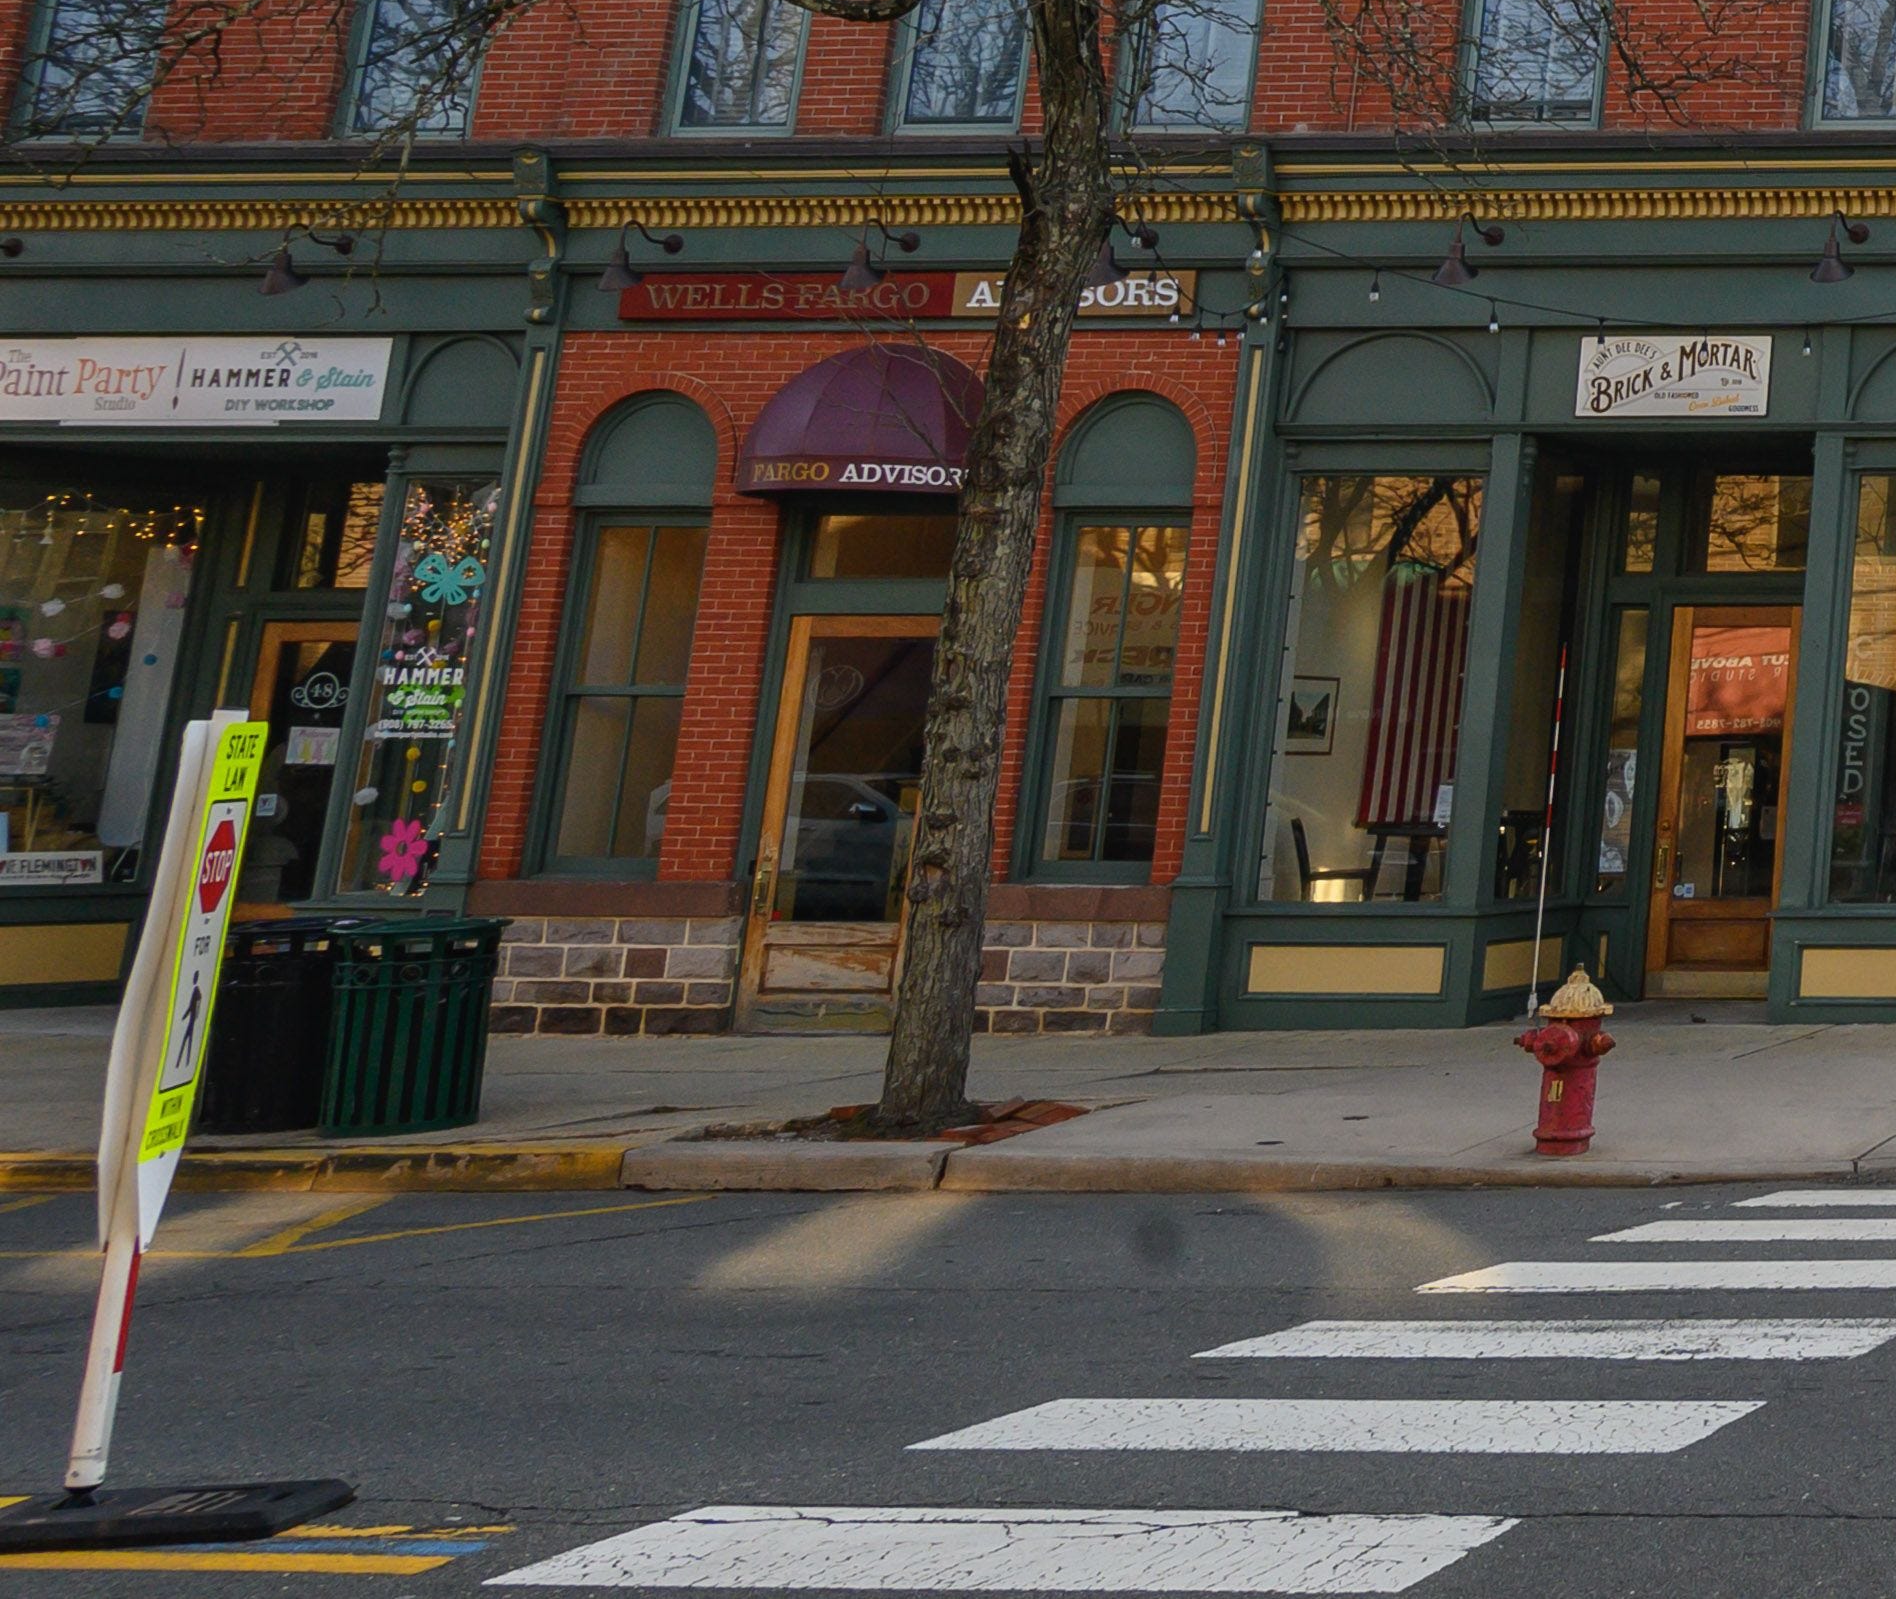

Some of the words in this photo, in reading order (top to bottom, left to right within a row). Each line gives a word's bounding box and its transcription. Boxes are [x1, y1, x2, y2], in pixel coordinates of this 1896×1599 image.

[646, 283, 785, 310] WELLS
[794, 282, 930, 309] FARGO
[966, 279, 1180, 307] ASORS
[8, 349, 32, 363] The
[1594, 348, 1613, 370] AUNT
[1615, 342, 1631, 354] DEE
[1634, 342, 1657, 360] DEE'S
[0, 360, 71, 396] aint
[72, 358, 167, 400] Party
[191, 368, 292, 388] HAMMER
[295, 368, 313, 387] &
[314, 366, 376, 392] Stain
[1591, 365, 1654, 413] BRICK
[1660, 361, 1672, 381] &
[1677, 341, 1756, 382] MORTAR
[94, 397, 136, 411] Studio
[224, 398, 251, 411] DIY
[255, 398, 334, 411] WORKSHOP
[753, 463, 829, 482] FARGO
[383, 667, 464, 685] HAMMER
[310, 683, 334, 698] 48
[226, 734, 259, 760] STATE
[224, 766, 248, 792] LAW
[202, 851, 234, 884] STOP
[194, 936, 211, 957] FOR
